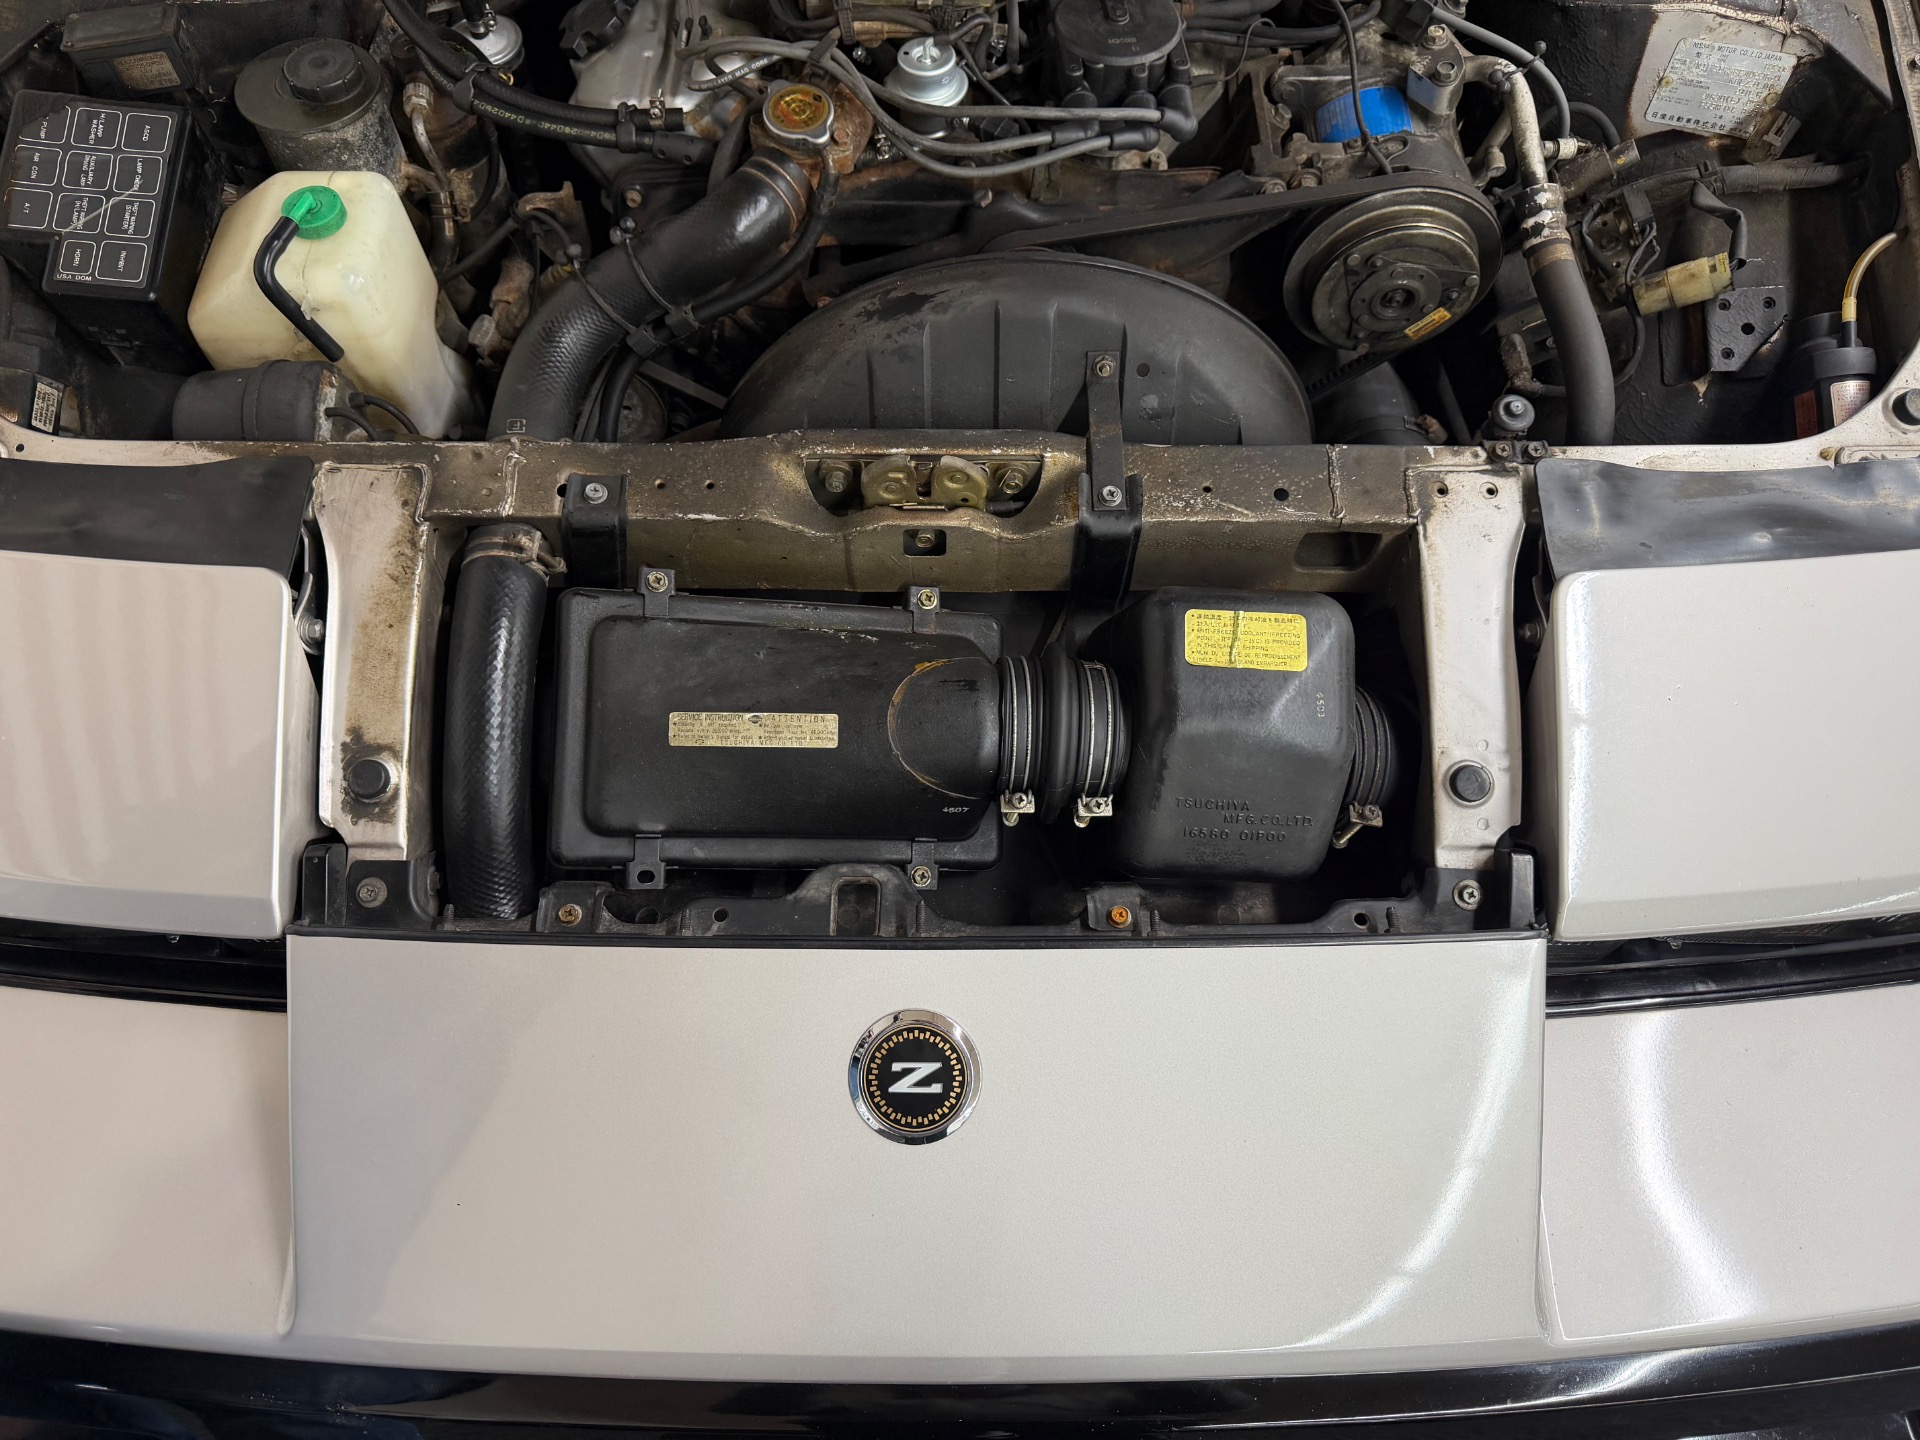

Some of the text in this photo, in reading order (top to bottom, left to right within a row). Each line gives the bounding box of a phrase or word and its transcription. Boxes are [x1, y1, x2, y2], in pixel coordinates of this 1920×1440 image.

[1718, 45, 1737, 54] MOTOR
[751, 58, 768, 70] CORE
[97, 113, 106, 138] H/LAMP
[1651, 111, 1726, 130] 日産自動車株式会社
[40, 121, 48, 139] PUMP
[89, 119, 98, 144] WASHER
[142, 124, 150, 142] ASCD
[30, 165, 38, 179] CON
[87, 155, 97, 185] AUXILIARY
[73, 248, 81, 267] HORN
[677, 713, 703, 721] SERVICE
[704, 713, 744, 722] INSTRUCTION
[771, 714, 826, 723] ATTENTION
[1175, 797, 1250, 811] TSUCHIYA
[888, 1061, 944, 1094] Z
